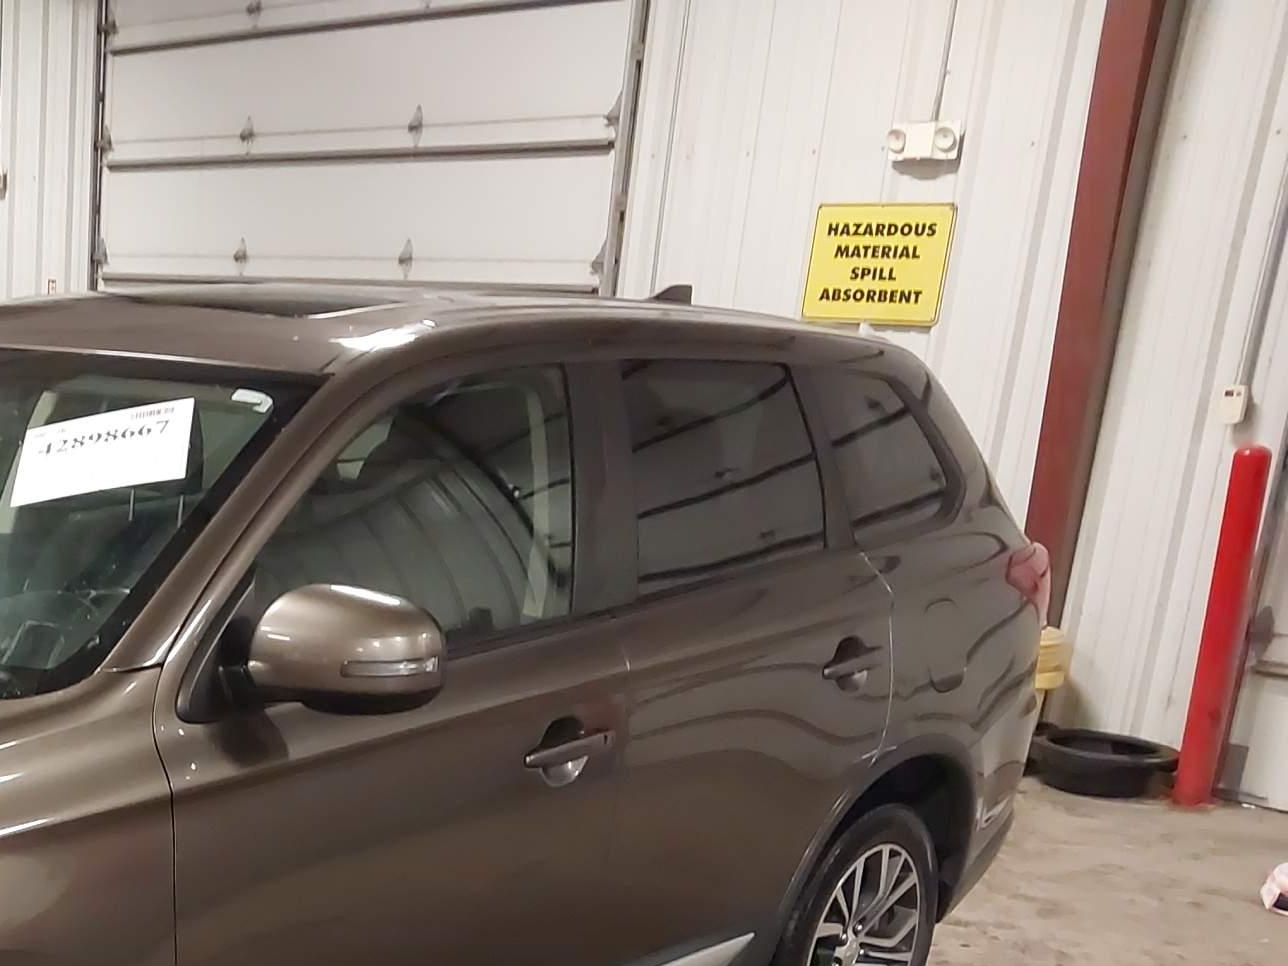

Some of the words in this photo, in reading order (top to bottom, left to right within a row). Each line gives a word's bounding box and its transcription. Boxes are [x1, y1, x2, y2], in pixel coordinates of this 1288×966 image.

[827, 223, 937, 237] HAZARDOUS
[834, 245, 920, 259] MATERIAL
[849, 267, 896, 281] SPILL
[819, 288, 922, 304] ABSORBENT
